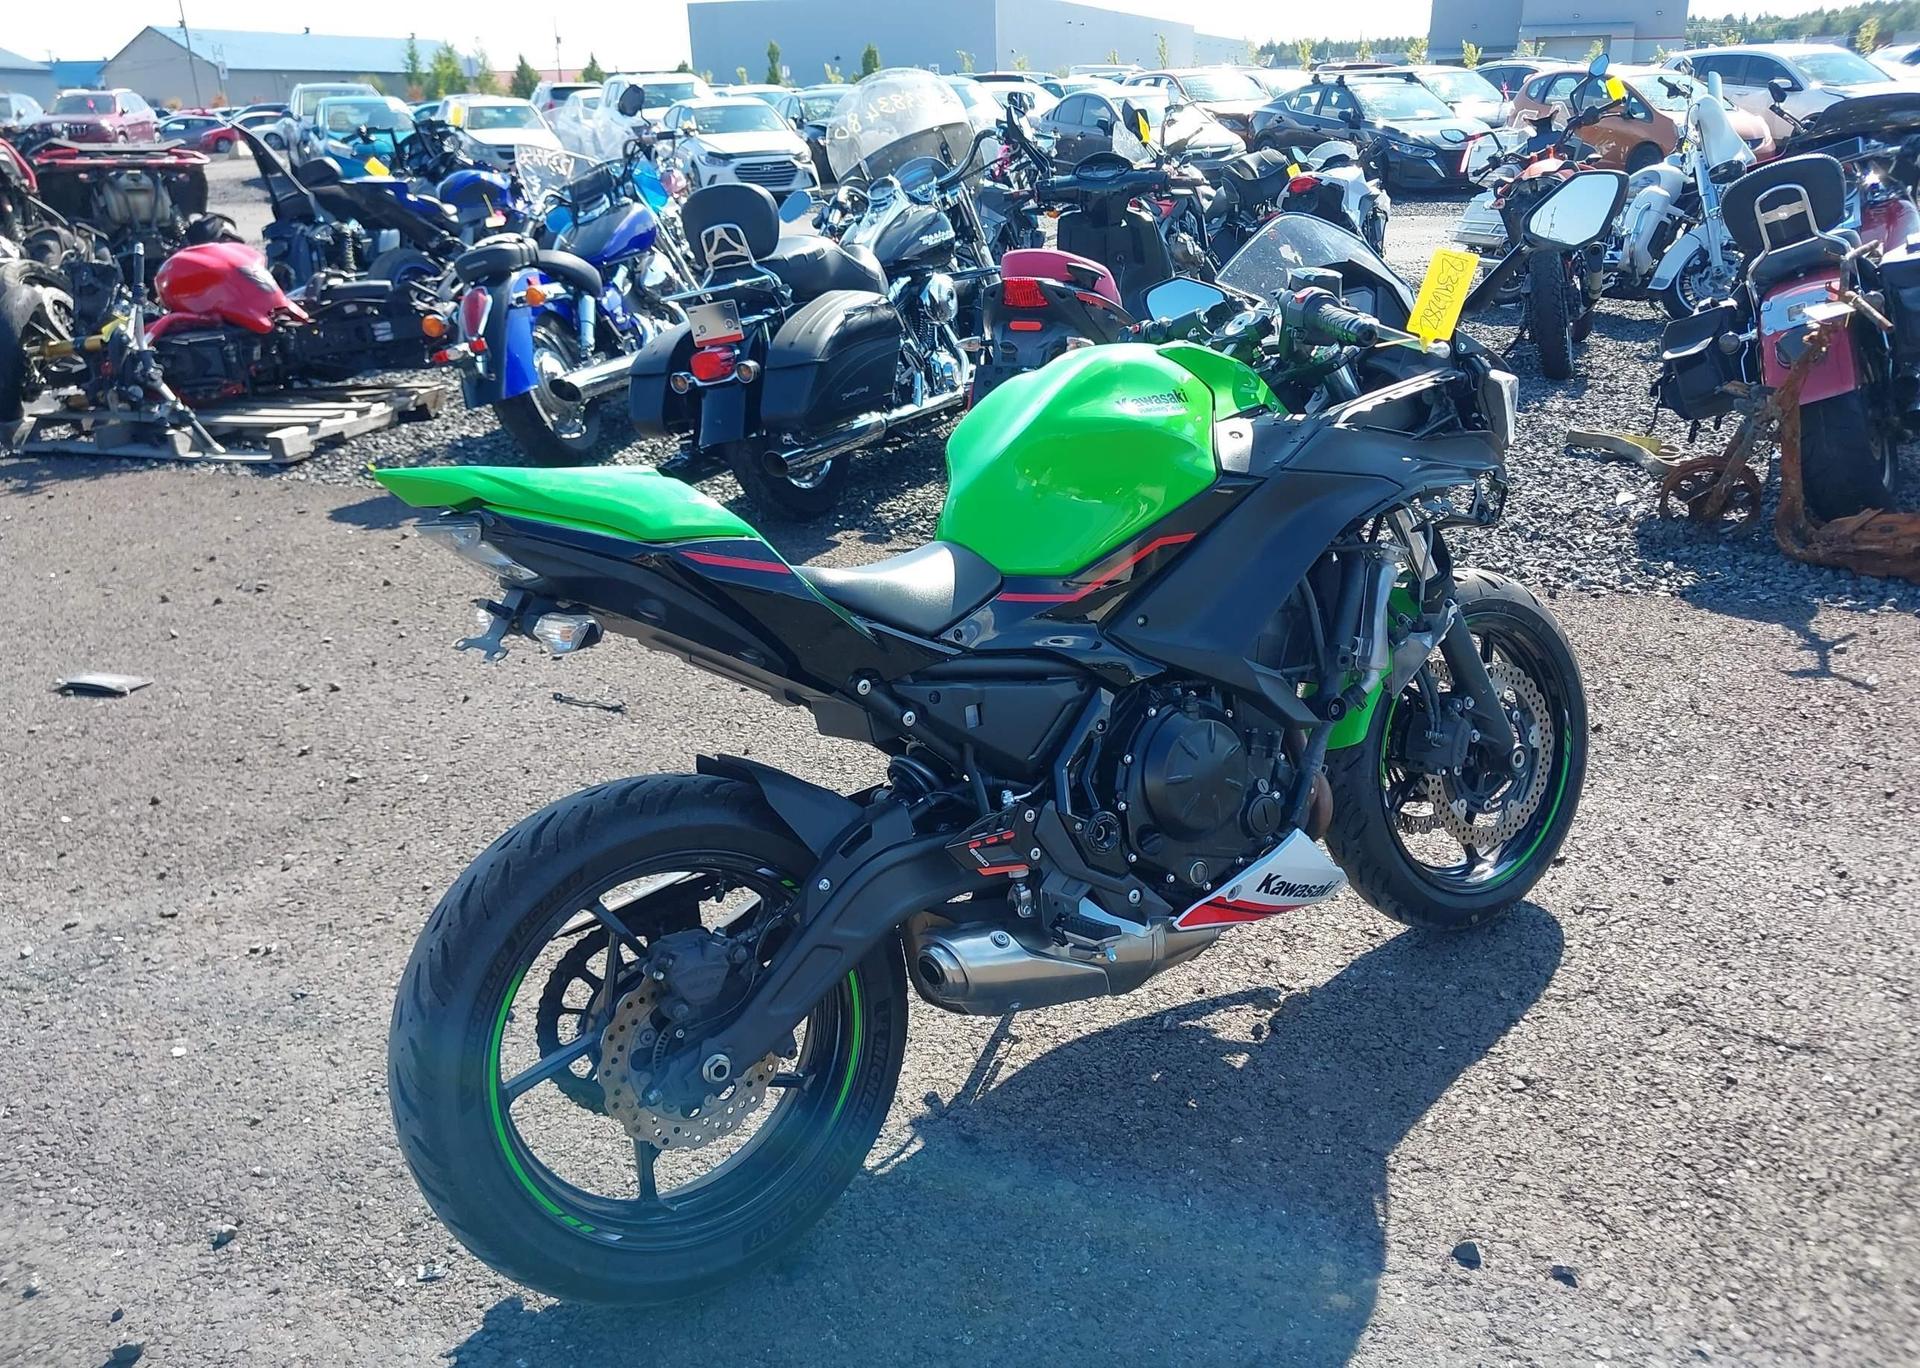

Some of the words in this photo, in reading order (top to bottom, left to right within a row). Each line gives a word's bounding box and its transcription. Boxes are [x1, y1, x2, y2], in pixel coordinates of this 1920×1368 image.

[1115, 388, 1189, 407] Kawasaki
[969, 847, 990, 867] 650
[1255, 872, 1340, 898] Kawasaki
